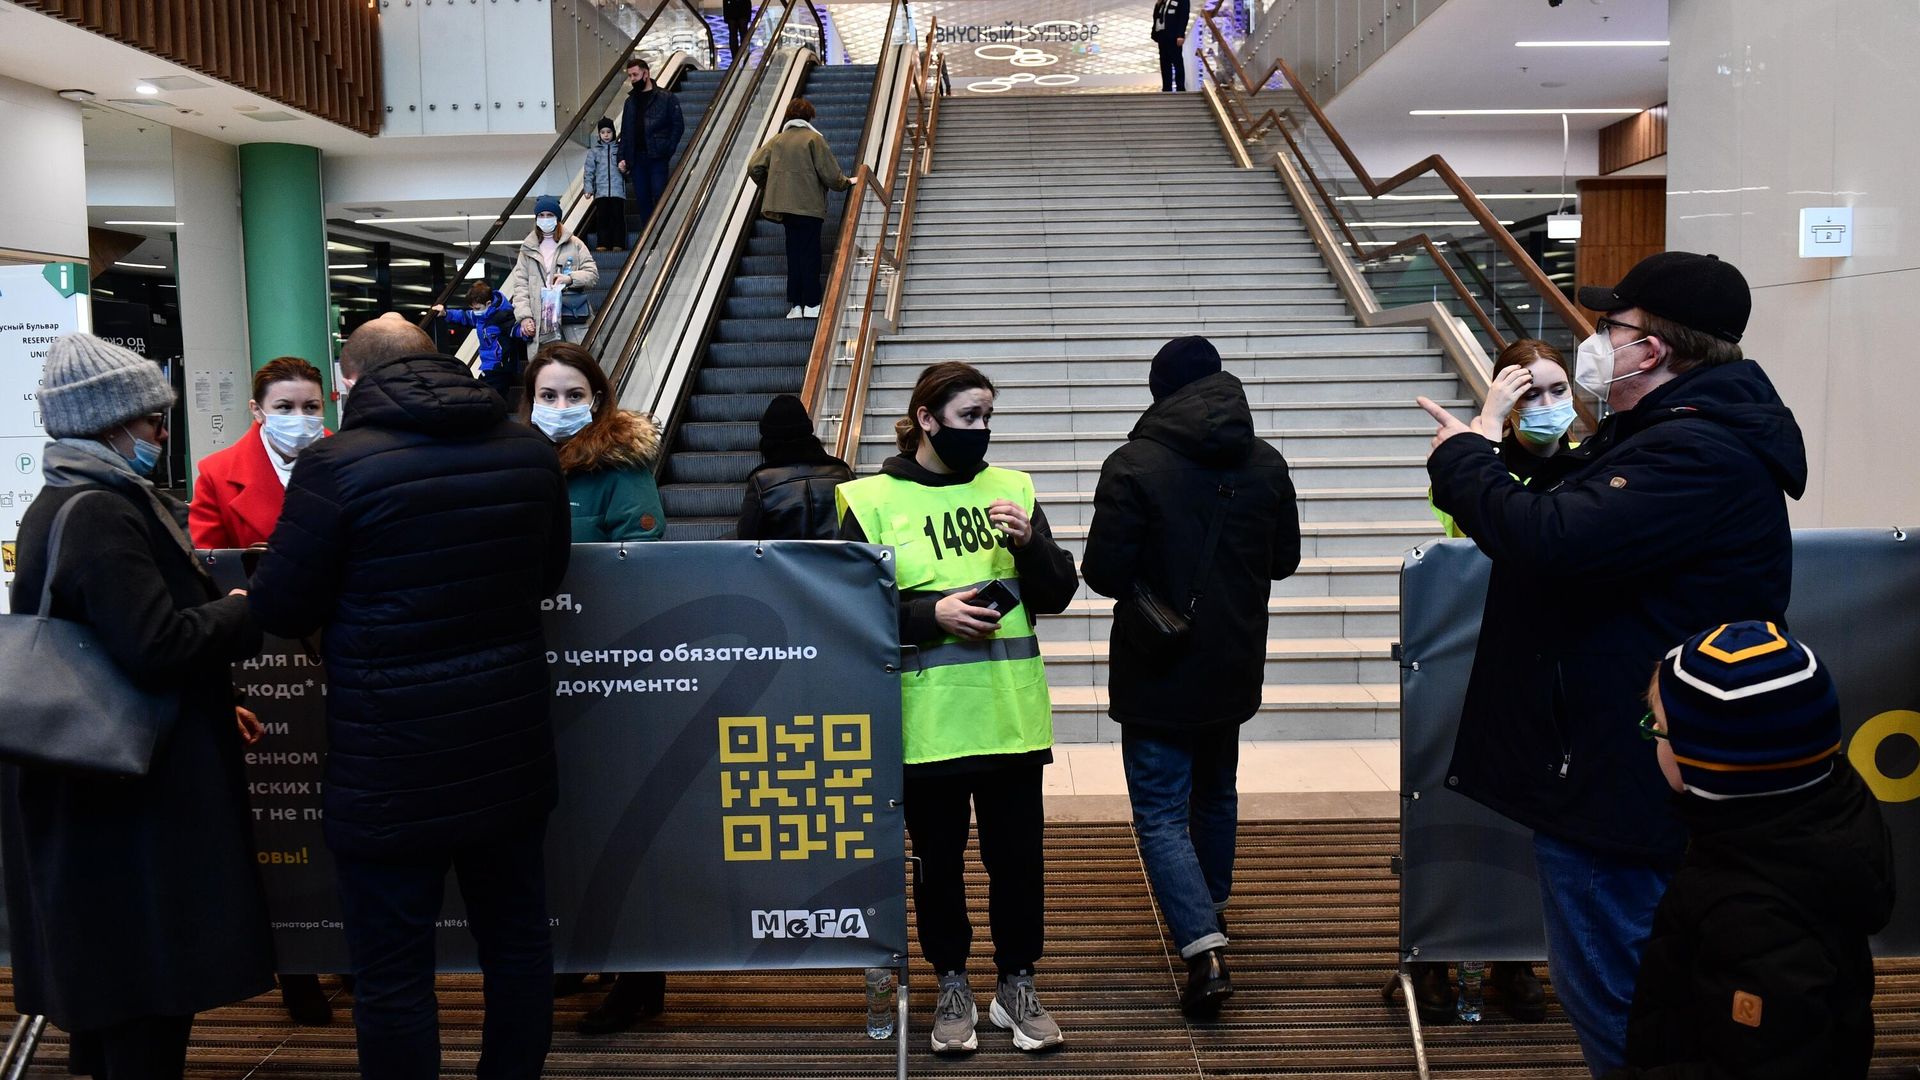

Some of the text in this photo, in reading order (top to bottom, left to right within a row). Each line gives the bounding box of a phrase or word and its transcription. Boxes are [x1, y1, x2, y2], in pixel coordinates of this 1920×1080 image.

[0, 323, 59, 332] усный Бульвар
[564, 650, 654, 667] центра
[659, 642, 818, 663] обязательно
[555, 677, 699, 698] документа:
[244, 752, 319, 765] енном
[269, 808, 298, 821] не
[255, 847, 309, 865] овы!
[271, 921, 320, 931] ернатора
[548, 917, 560, 927] 21
